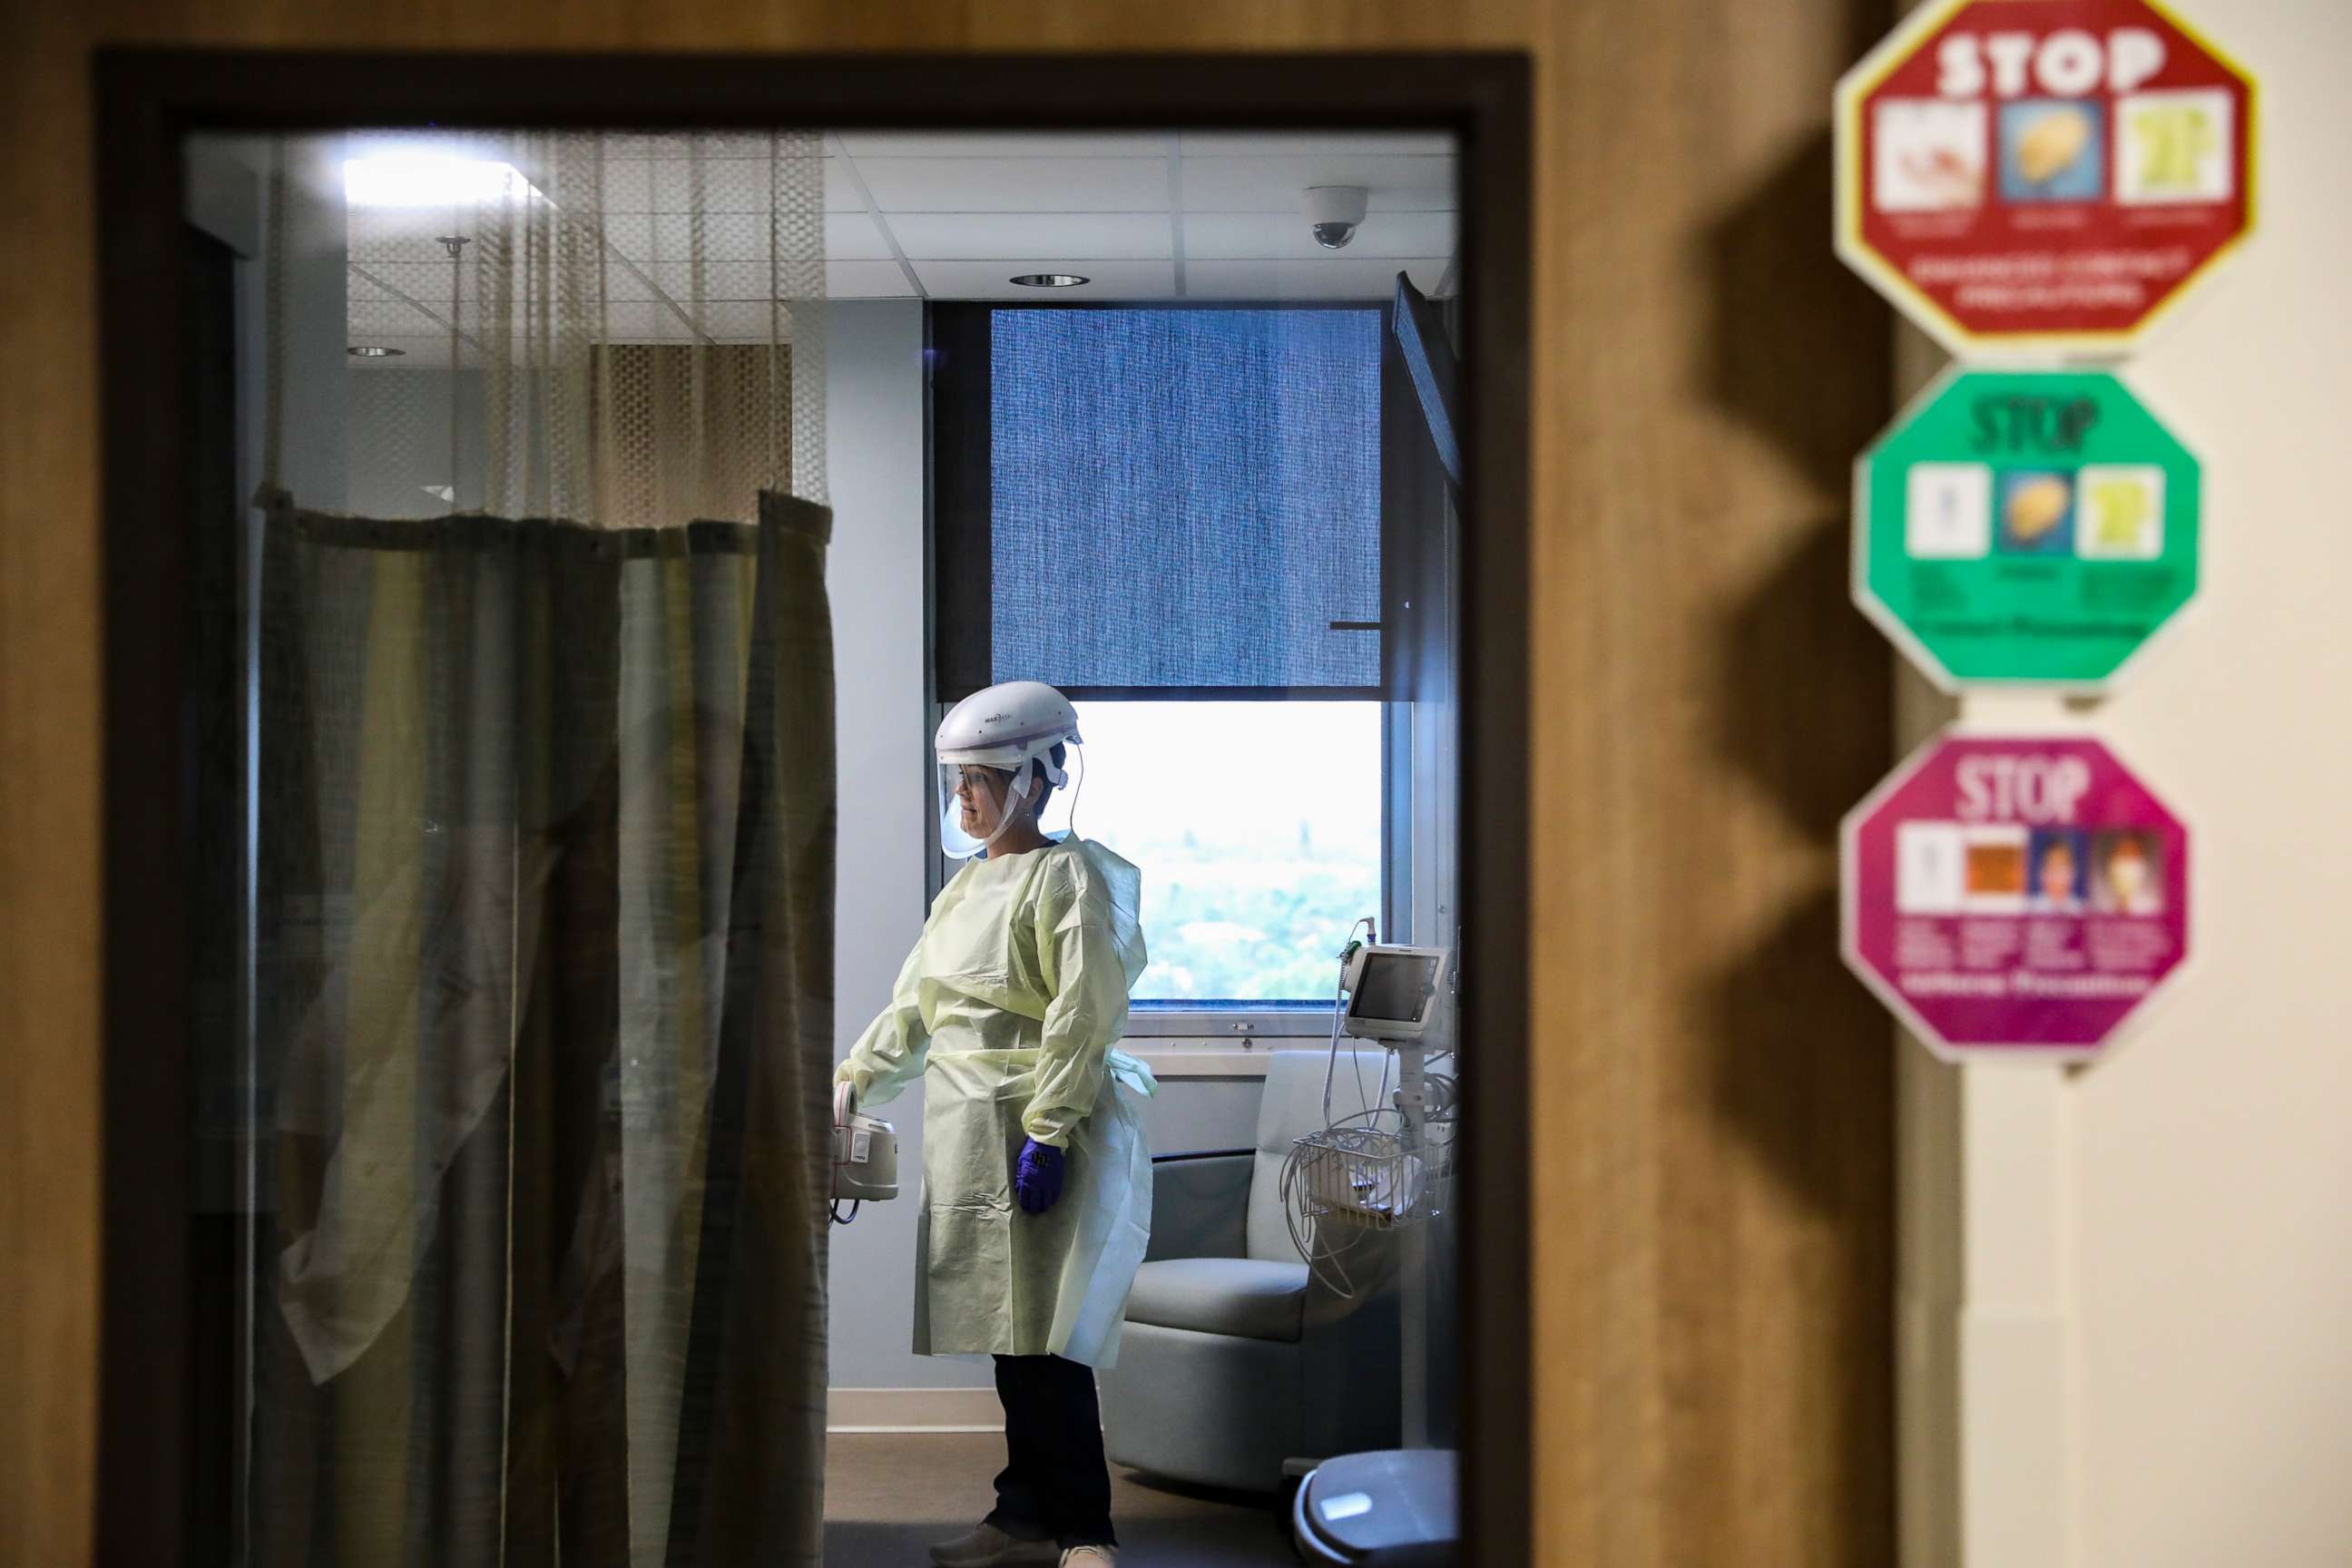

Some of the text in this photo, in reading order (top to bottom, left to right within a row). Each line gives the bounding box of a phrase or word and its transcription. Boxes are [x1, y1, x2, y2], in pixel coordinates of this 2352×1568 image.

[1936, 29, 2166, 97] STOP
[1970, 392, 2102, 456] STOP
[1955, 755, 2092, 820] STOP
